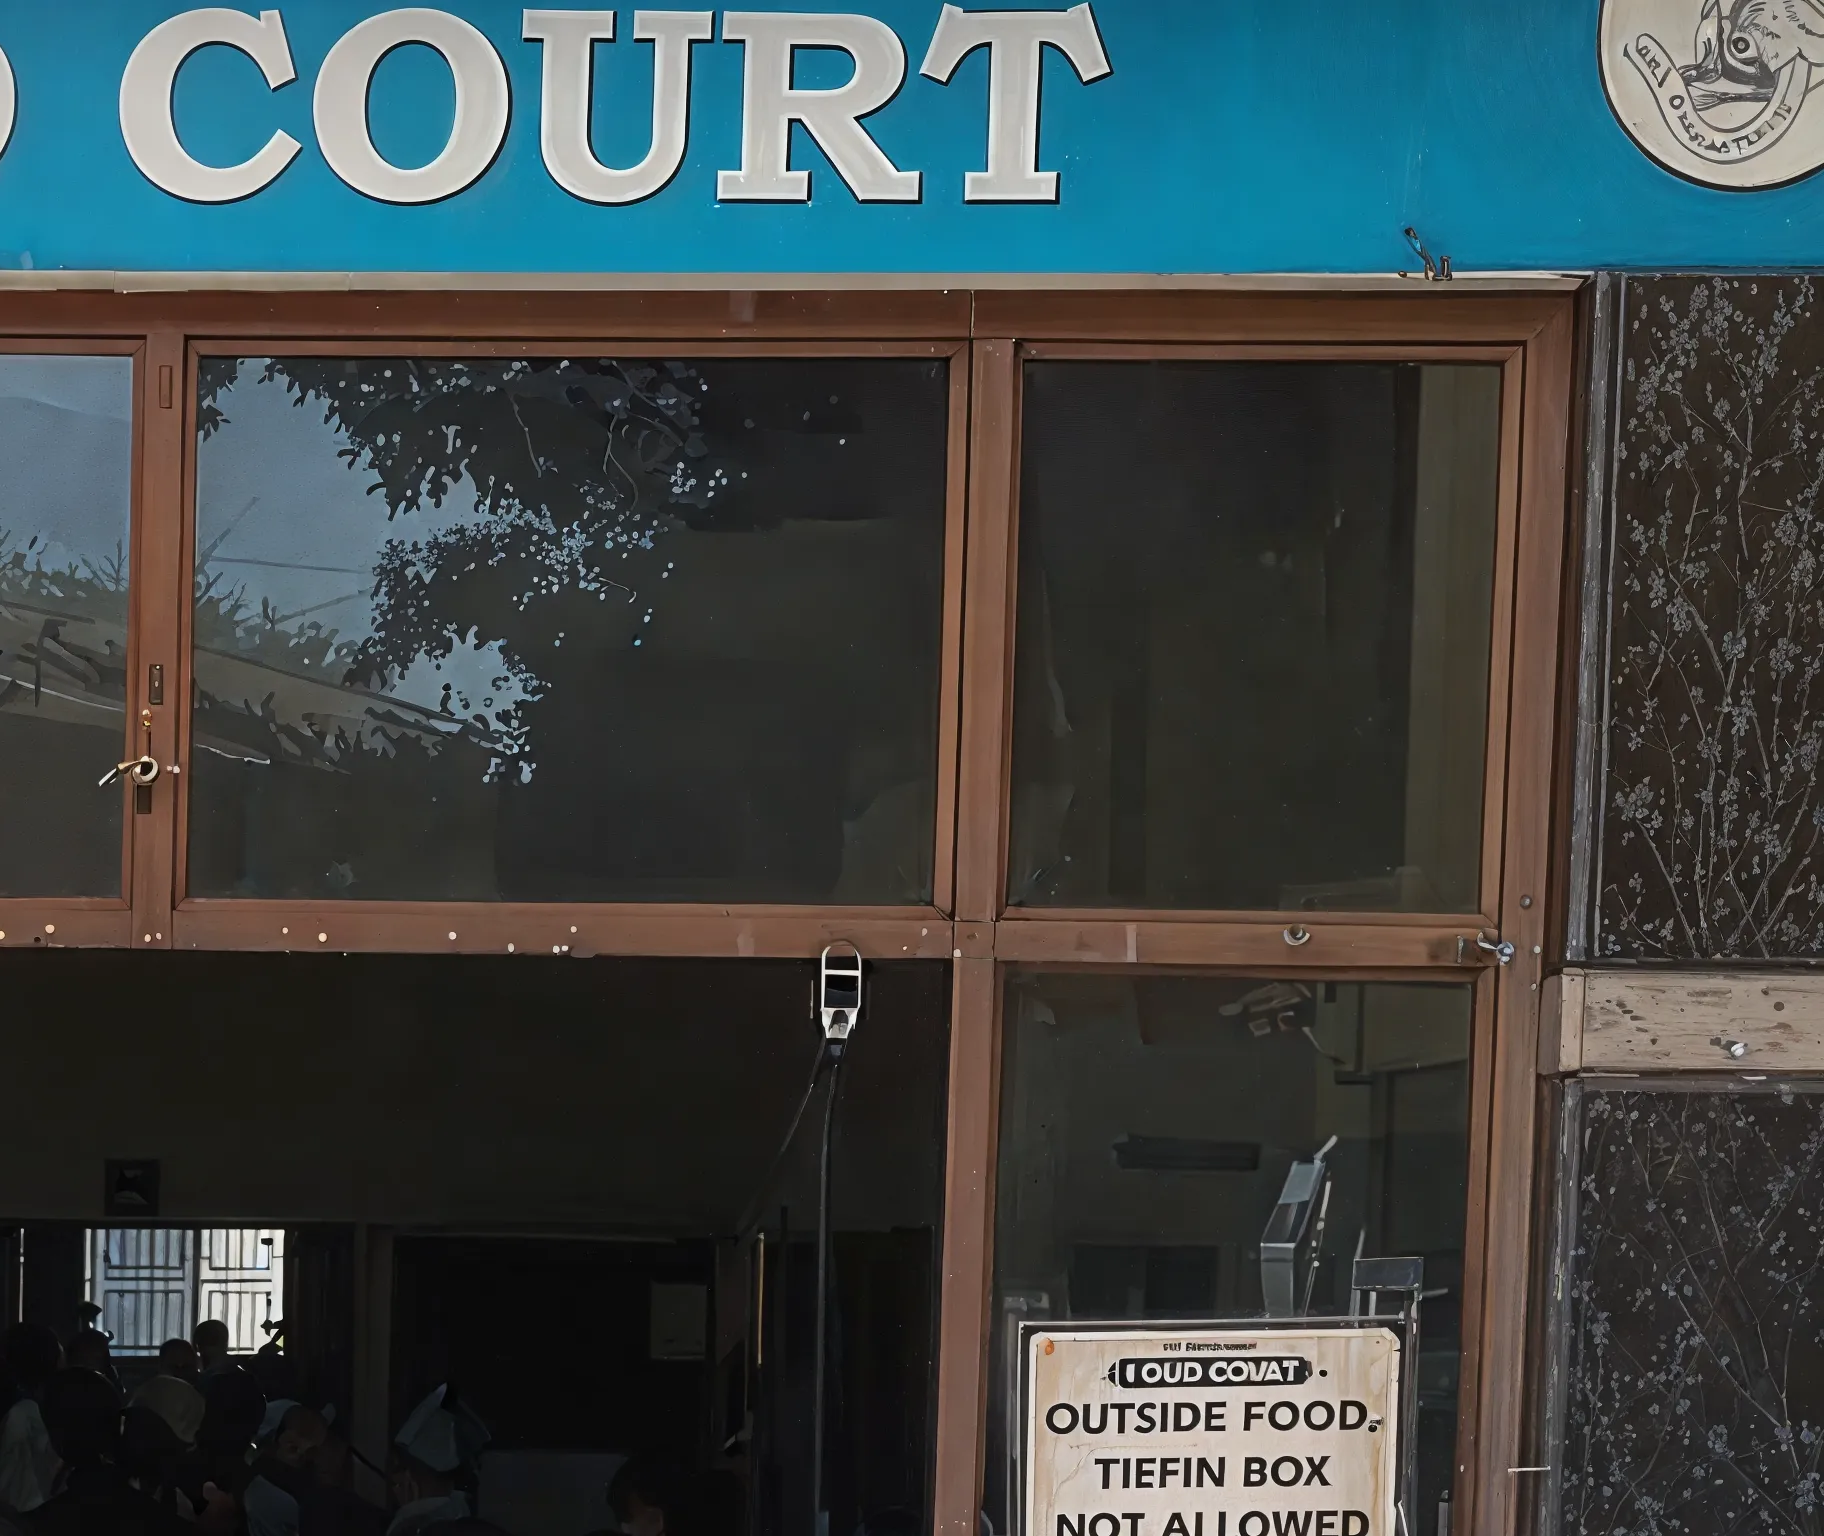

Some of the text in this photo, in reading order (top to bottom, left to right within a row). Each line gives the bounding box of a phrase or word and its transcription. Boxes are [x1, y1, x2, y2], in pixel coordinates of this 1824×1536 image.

[118, 3, 1116, 207] COURT
[1045, 1400, 1228, 1435] OUTSIDE
[1094, 1454, 1333, 1490] TIEFIN BOX
